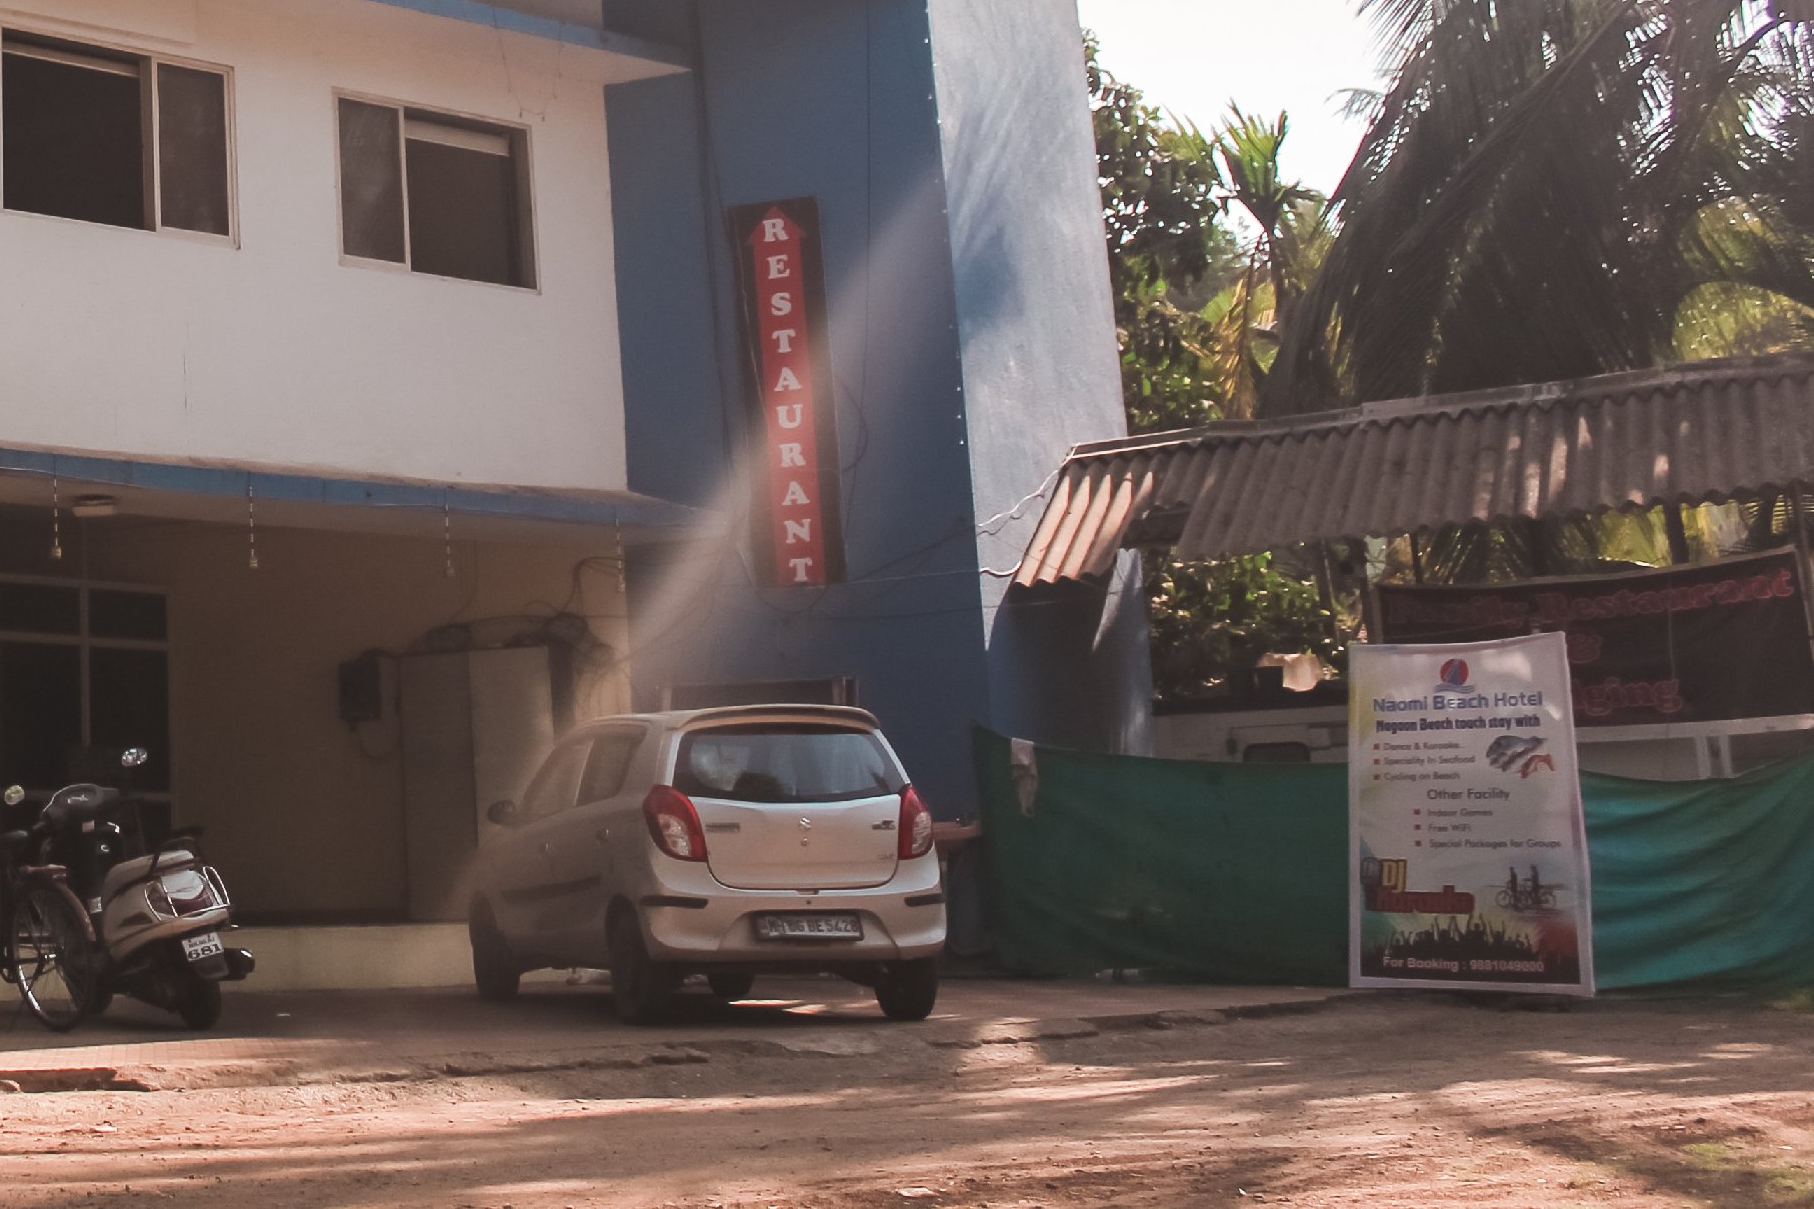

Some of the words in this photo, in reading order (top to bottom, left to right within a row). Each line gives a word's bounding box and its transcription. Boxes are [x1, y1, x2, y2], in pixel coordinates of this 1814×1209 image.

[763, 218, 813, 582] RESTAURANT
[1373, 696, 1428, 712] Naomi
[1433, 694, 1489, 710] Beach
[1494, 691, 1543, 708] Hotel
[1419, 717, 1454, 731] Beach
[1455, 716, 1486, 729] touch
[1488, 717, 1512, 731] stay
[1515, 714, 1541, 728] with
[1427, 789, 1463, 800] Other
[1467, 788, 1510, 800] Facility
[1379, 859, 1407, 893] DJ
[188, 944, 222, 960] 681
[1383, 956, 1403, 968] For
[1406, 957, 1459, 972] Booking
